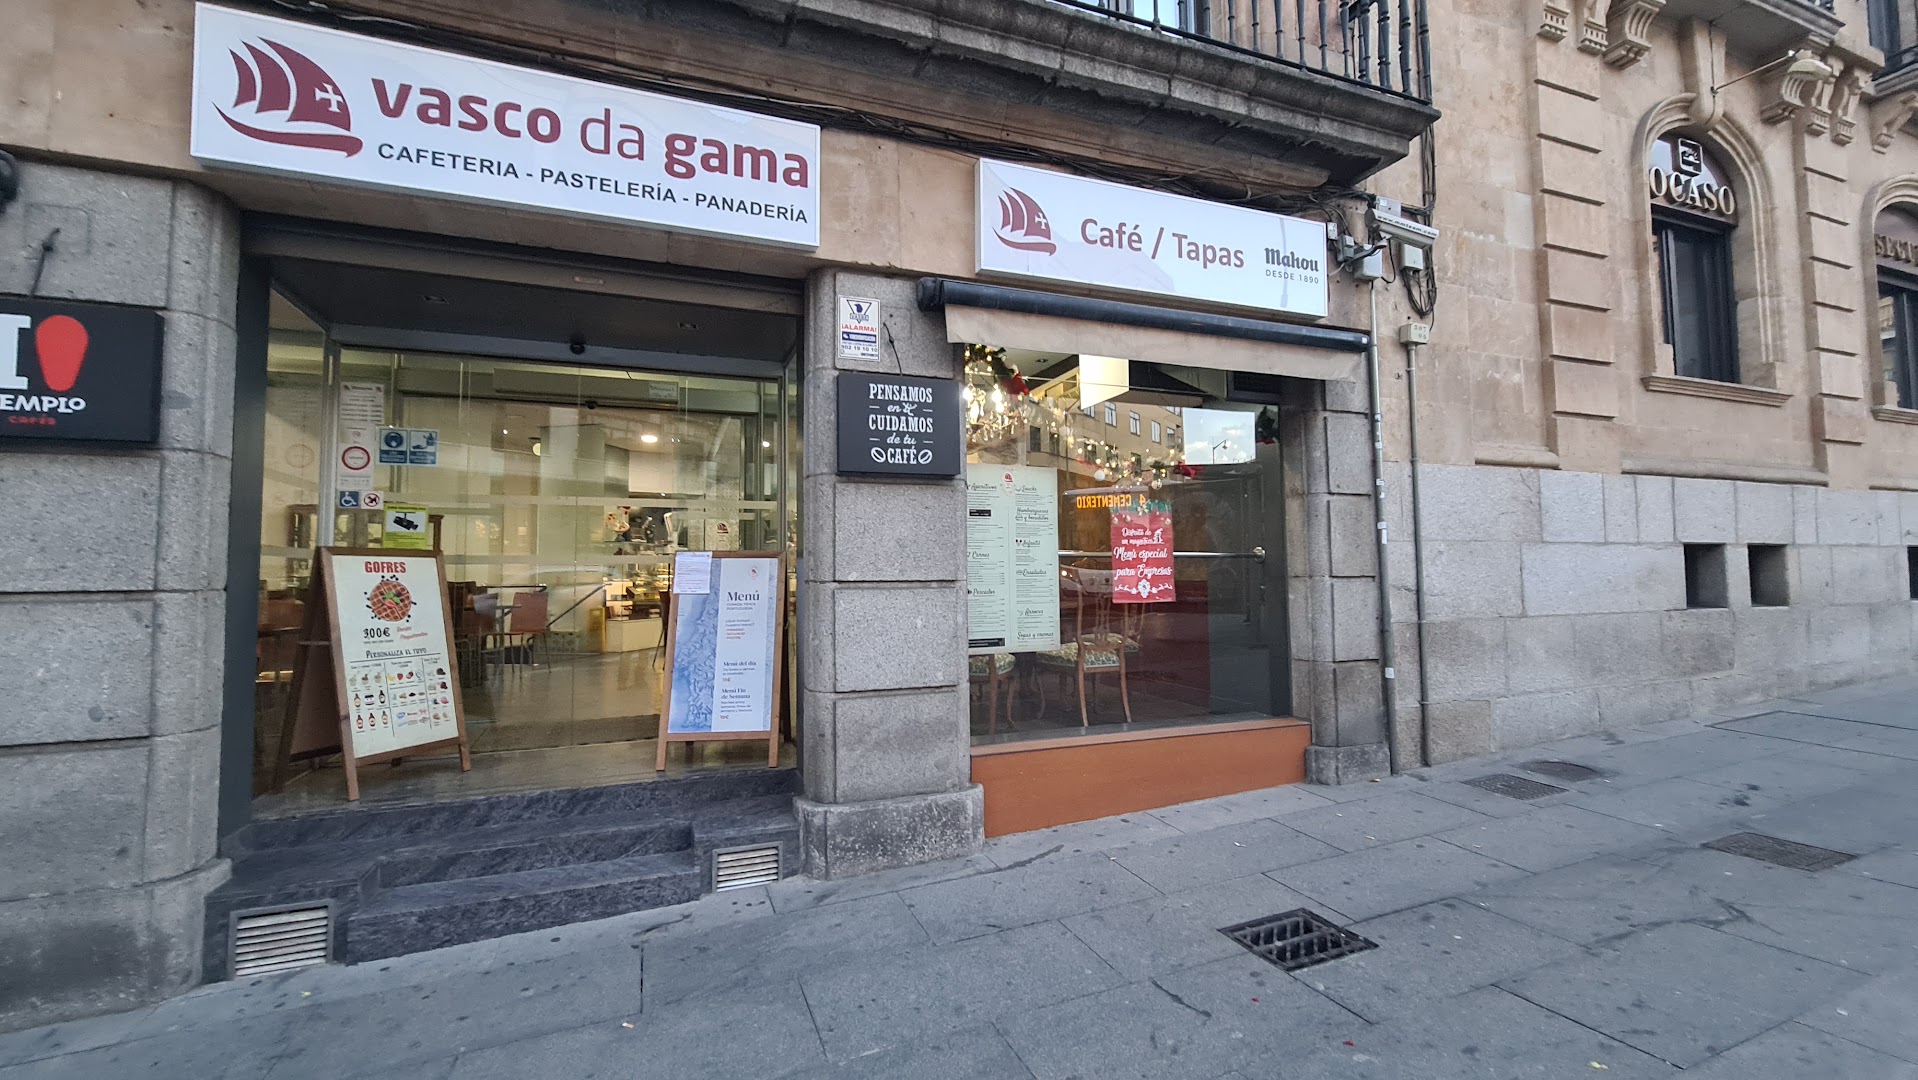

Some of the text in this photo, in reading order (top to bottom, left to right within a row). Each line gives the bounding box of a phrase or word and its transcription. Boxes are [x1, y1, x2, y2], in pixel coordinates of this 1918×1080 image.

[371, 78, 808, 188] vasco da gama
[378, 143, 519, 178] CAFETERIA
[541, 168, 676, 203] PASTELERÍA
[695, 192, 808, 223] PANADERÍA
[1650, 166, 1735, 215] OCASO
[1081, 218, 1143, 252] Café
[1172, 232, 1245, 269] Tapas
[1264, 247, 1319, 272] Mahou
[1265, 269, 1319, 284] DESDE 1890
[869, 383, 933, 403] PENSAMOS
[887, 404, 901, 412] en
[869, 414, 933, 433] CUIDAMOS
[887, 432, 917, 445] de tu
[887, 446, 917, 464] CAFÉ
[1139, 548, 1167, 562] especial
[365, 561, 406, 573] GOFRES
[1115, 564, 1172, 580] para Empresas
[727, 590, 760, 601] Menú
